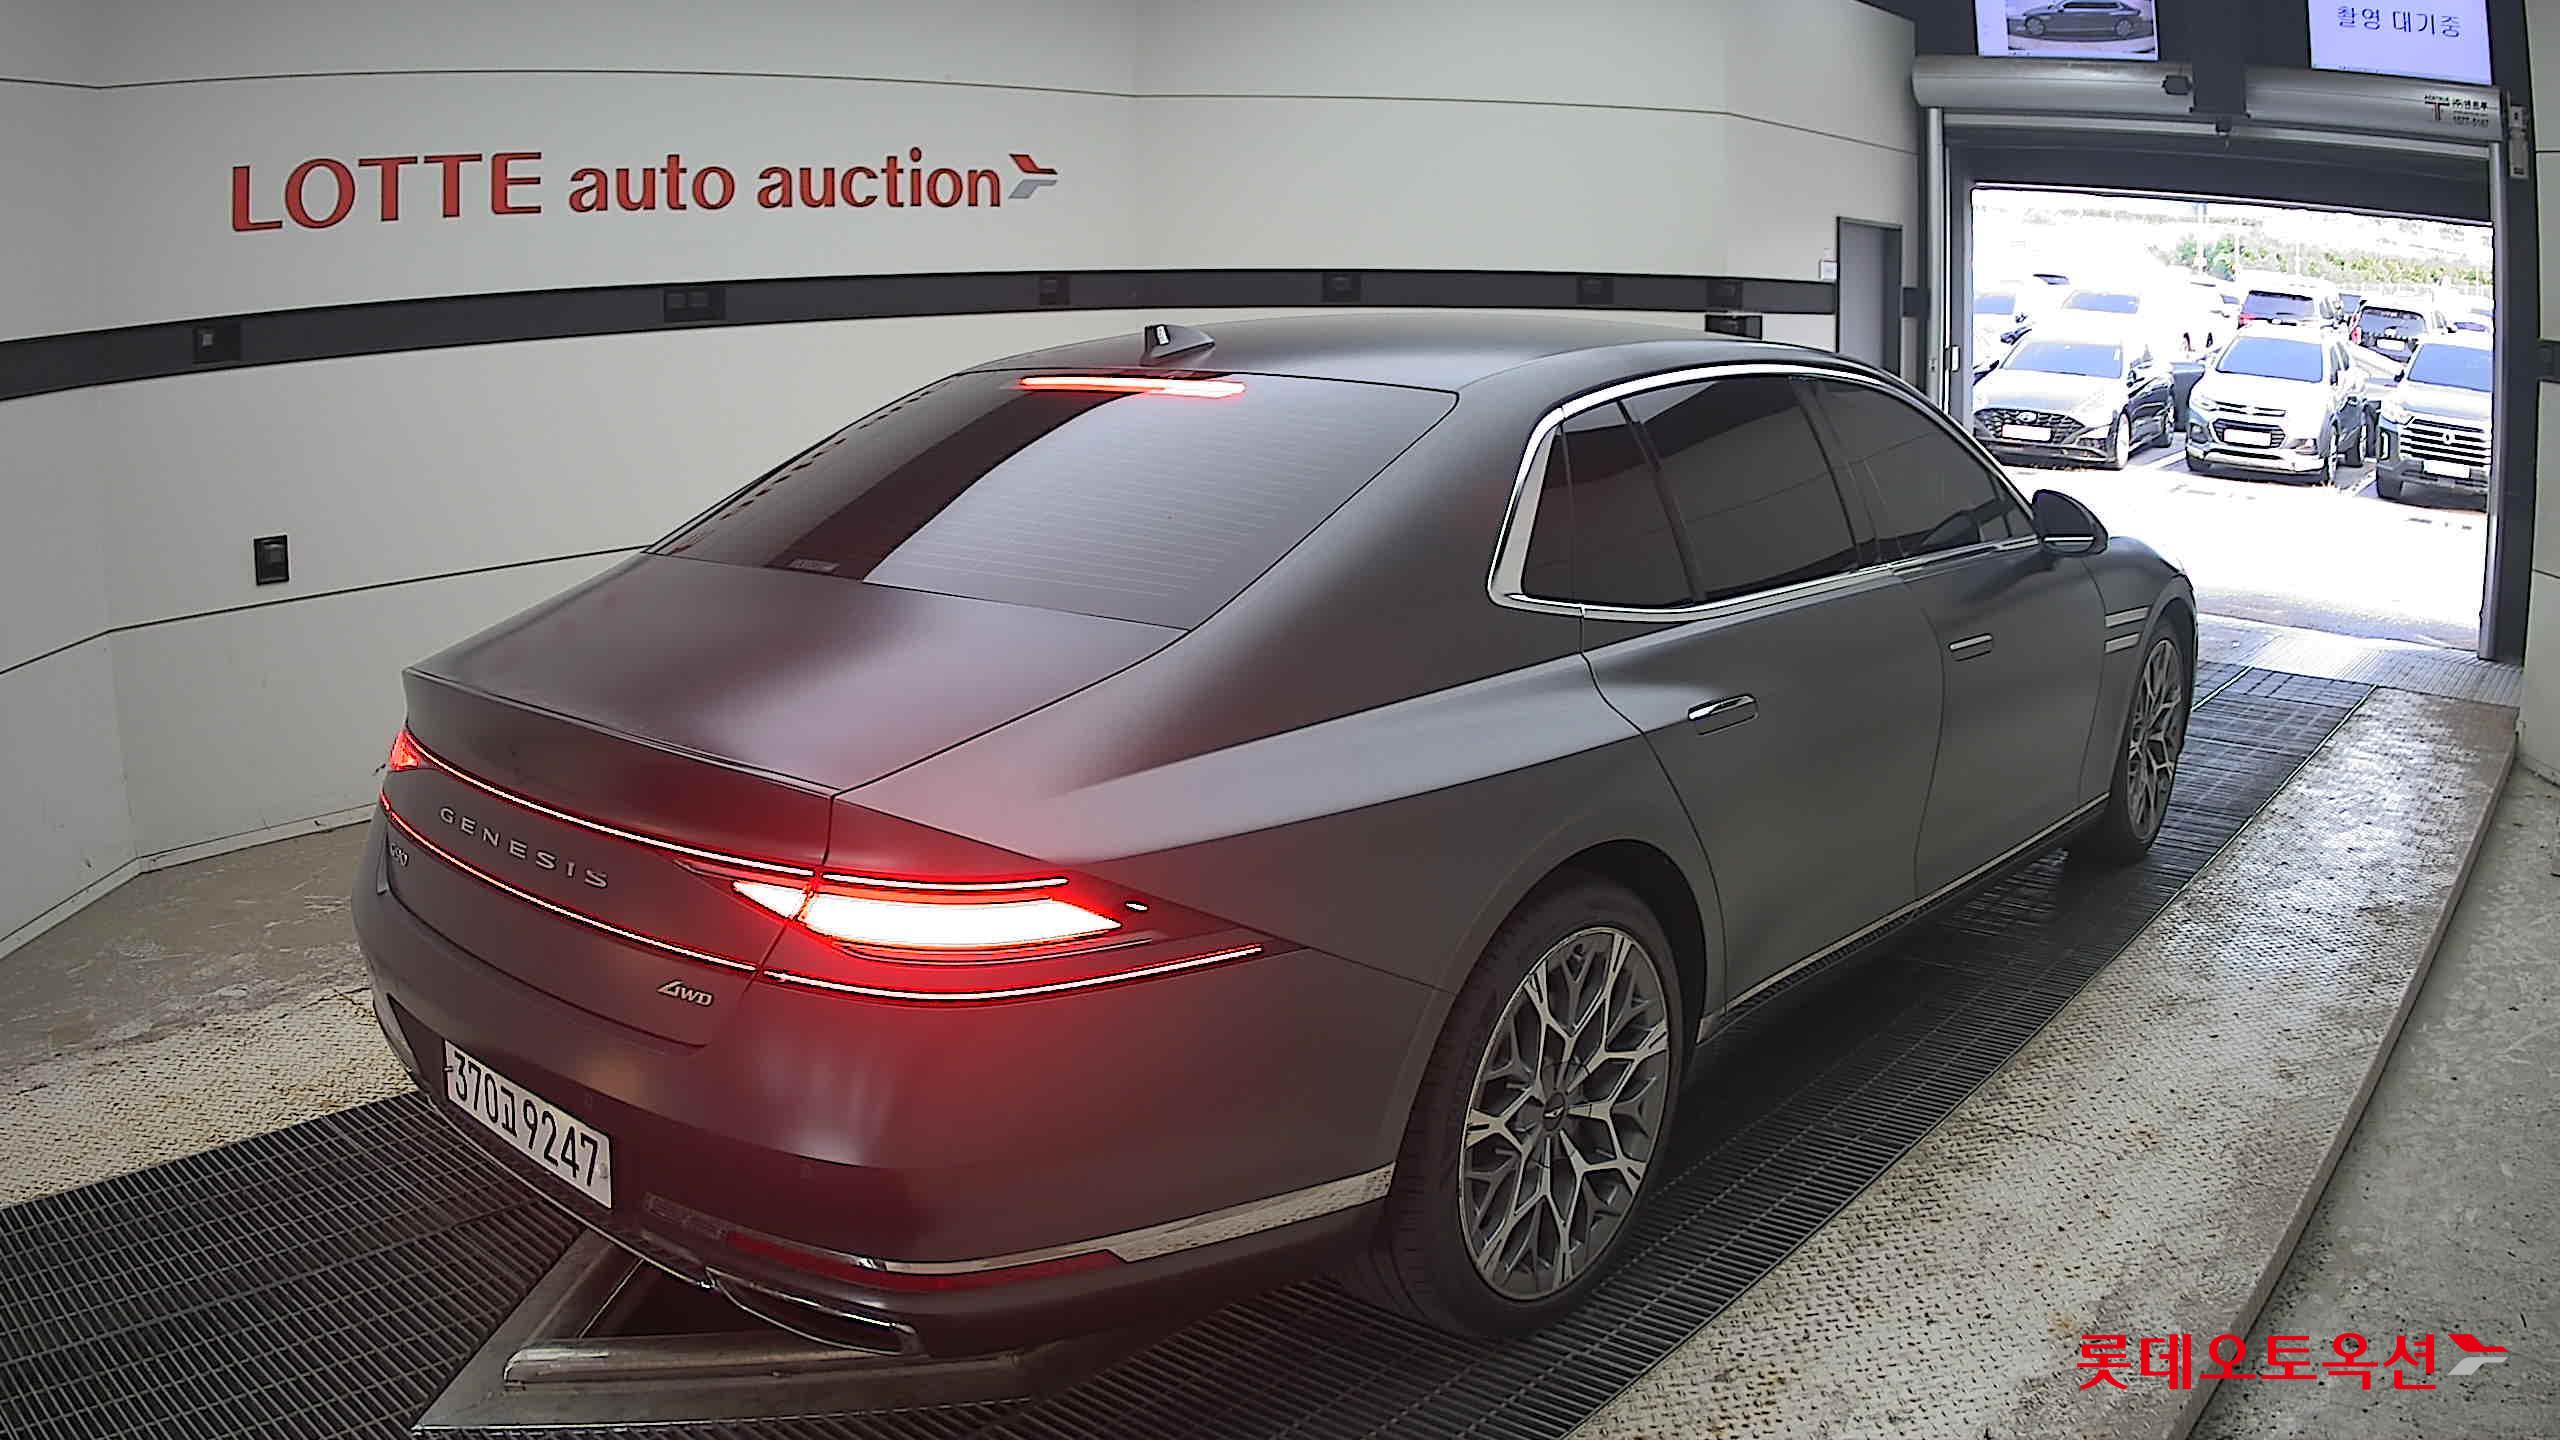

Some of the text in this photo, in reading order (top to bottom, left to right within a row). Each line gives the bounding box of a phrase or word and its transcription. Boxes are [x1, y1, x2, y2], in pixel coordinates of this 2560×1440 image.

[2337, 6, 2460, 38] 촬영 대기중
[231, 147, 1002, 233] LOTTE auto auction
[440, 807, 608, 888] GENESIS
[657, 980, 713, 1006] 4WD
